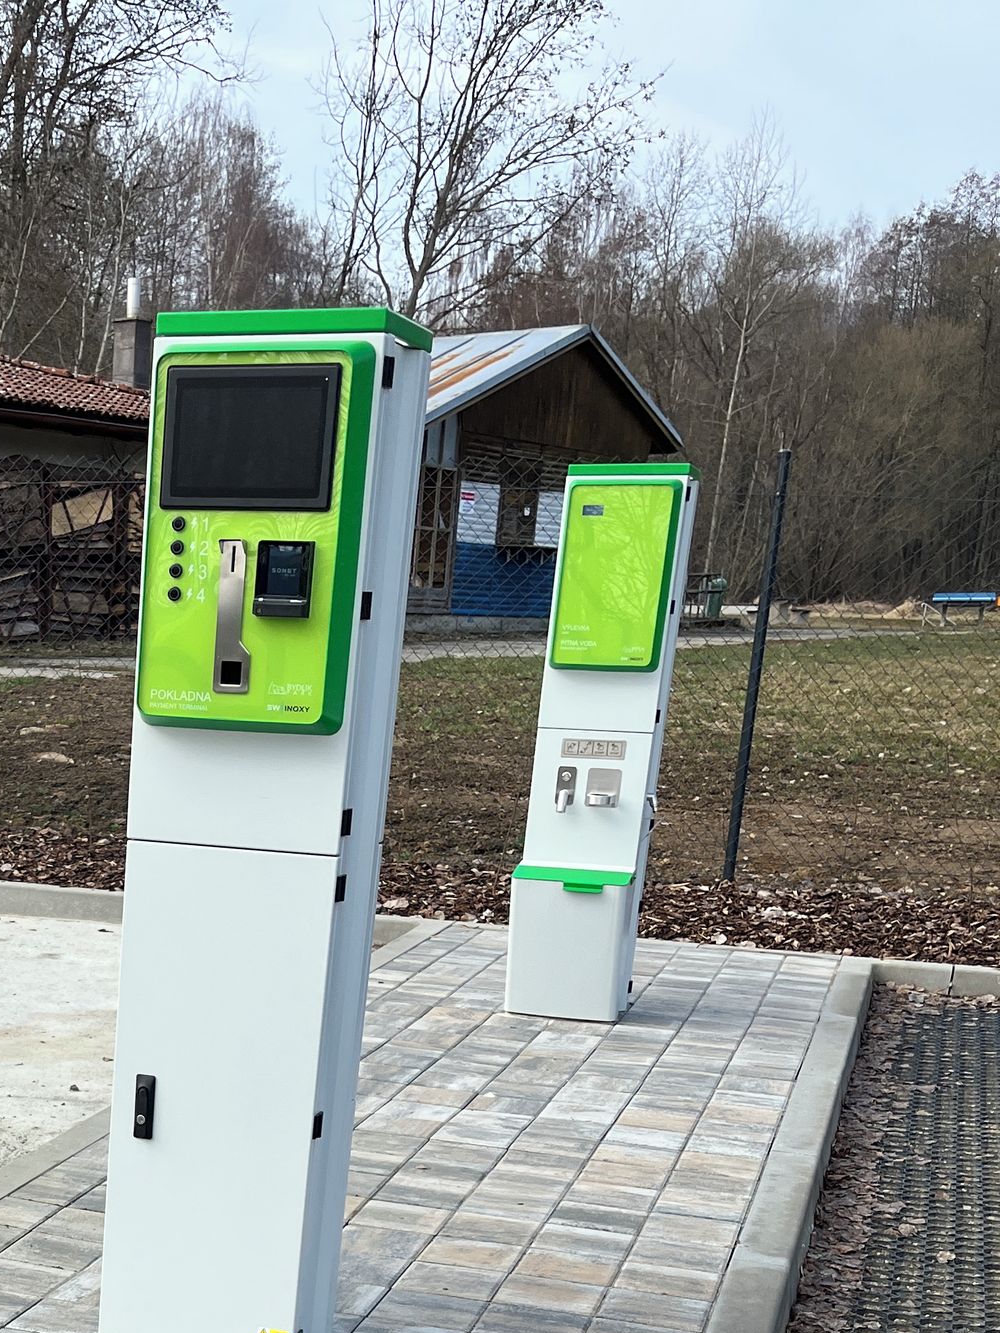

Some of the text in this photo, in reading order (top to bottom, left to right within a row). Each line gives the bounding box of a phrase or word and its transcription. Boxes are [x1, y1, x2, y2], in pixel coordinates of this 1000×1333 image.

[202, 517, 209, 532] 1
[200, 541, 209, 556] 2
[198, 564, 207, 579] 3
[196, 588, 205, 603] 4
[150, 689, 212, 702] POKLADNA
